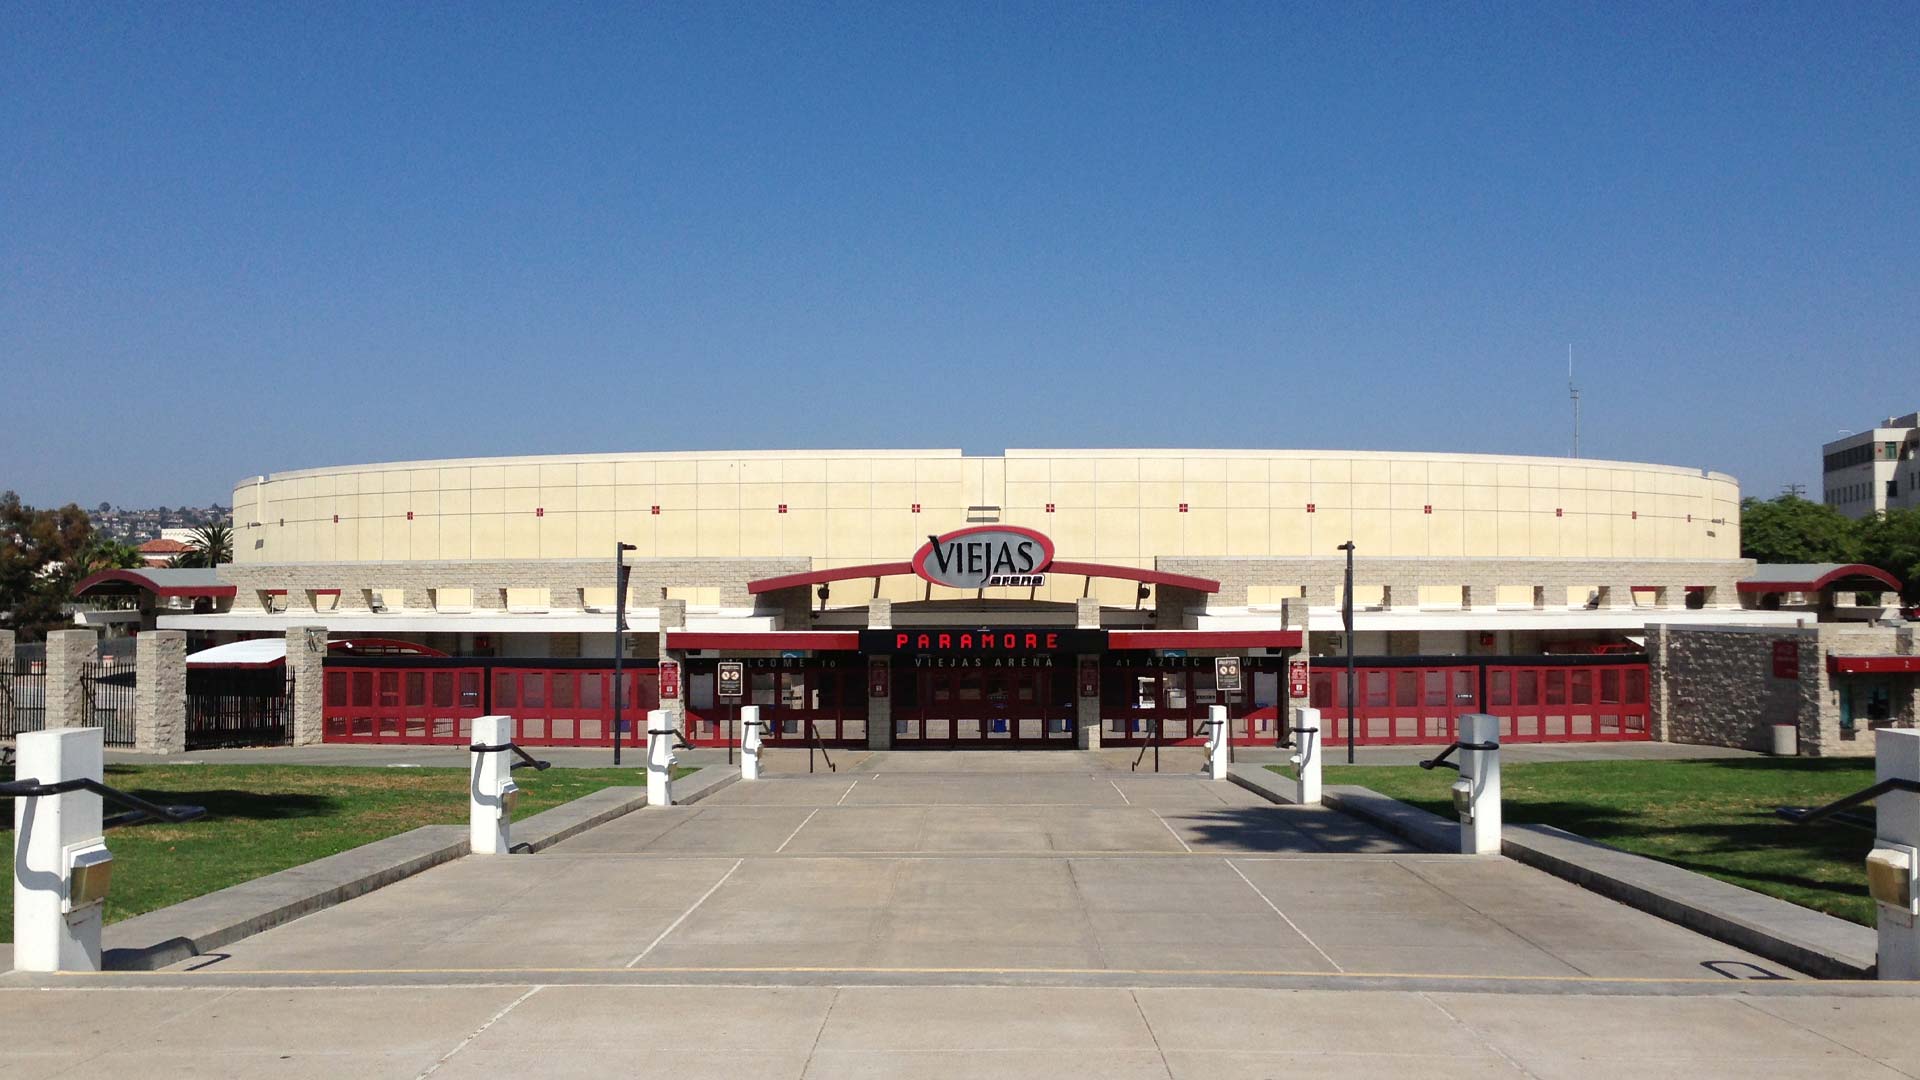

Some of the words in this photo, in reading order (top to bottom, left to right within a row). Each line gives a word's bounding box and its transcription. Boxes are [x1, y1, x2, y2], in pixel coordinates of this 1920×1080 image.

[928, 535, 1034, 584] VIEJAS
[989, 575, 1044, 586] arena
[896, 634, 1058, 649] PARAMORE
[720, 658, 805, 668] LCOME
[915, 658, 982, 668] VIEJAS
[994, 657, 1053, 668] ARENA
[1145, 657, 1200, 667] AZTEC
